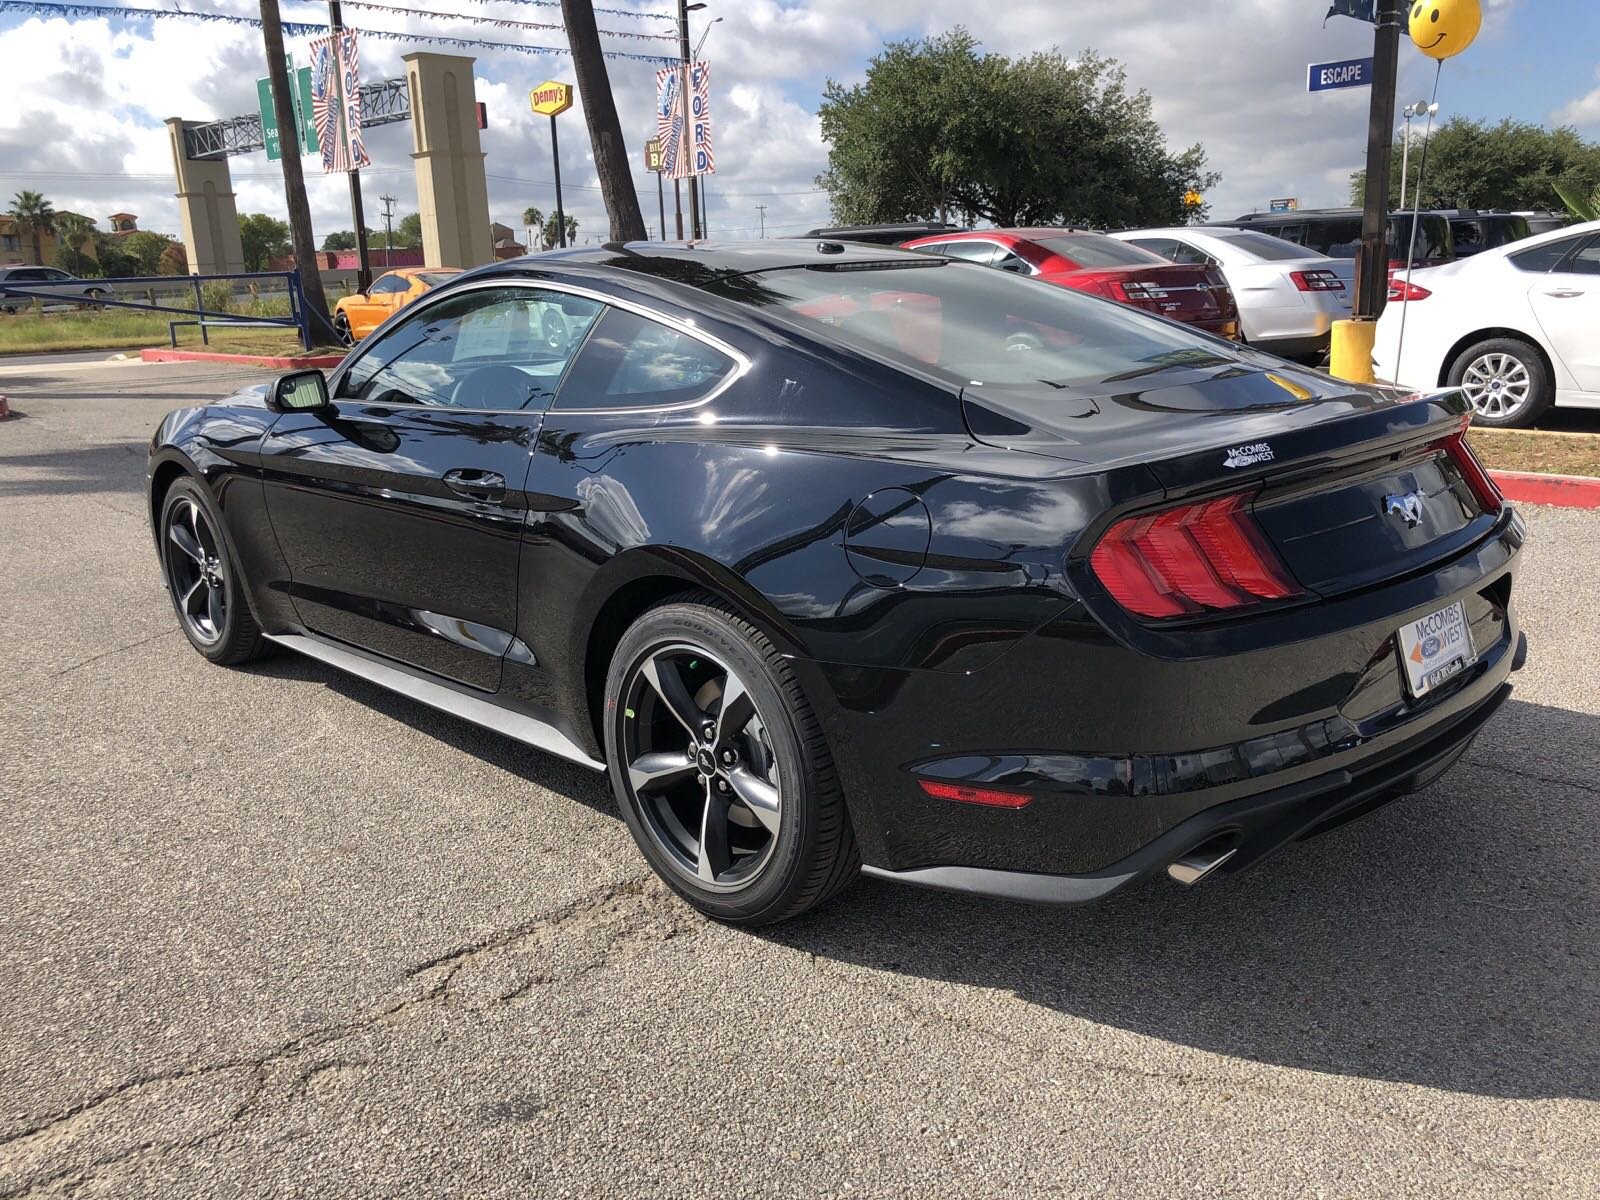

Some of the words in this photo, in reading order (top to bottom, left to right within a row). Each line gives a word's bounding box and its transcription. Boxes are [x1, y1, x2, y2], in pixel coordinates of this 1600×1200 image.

[1320, 64, 1362, 85] ESCAPE
[342, 36, 361, 164] FORD
[533, 86, 564, 107] Denny's
[691, 66, 708, 171] FORD
[649, 143, 661, 152] BIL
[1253, 450, 1275, 463] WEST
[1415, 604, 1460, 640] McCOMBS
[1442, 622, 1464, 647] WEST
